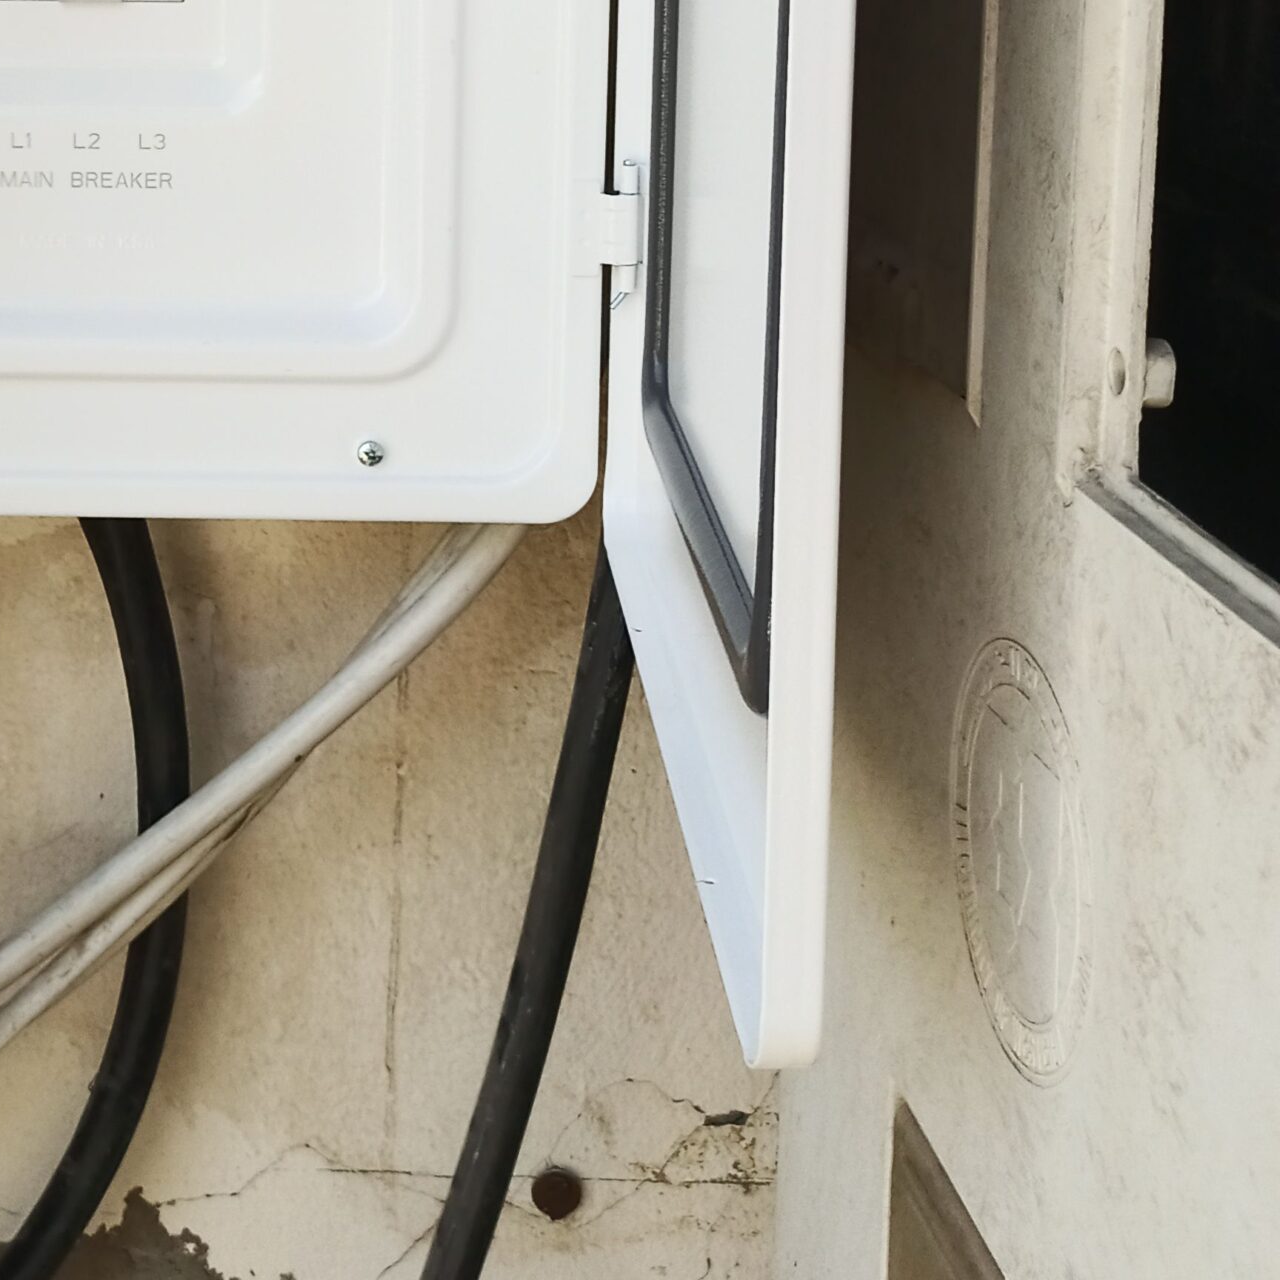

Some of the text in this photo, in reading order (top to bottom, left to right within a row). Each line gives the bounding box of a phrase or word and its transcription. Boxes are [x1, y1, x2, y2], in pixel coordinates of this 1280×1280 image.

[10, 132, 166, 150] L1 L2 L3
[0, 171, 172, 189] MAIN BREAKER
